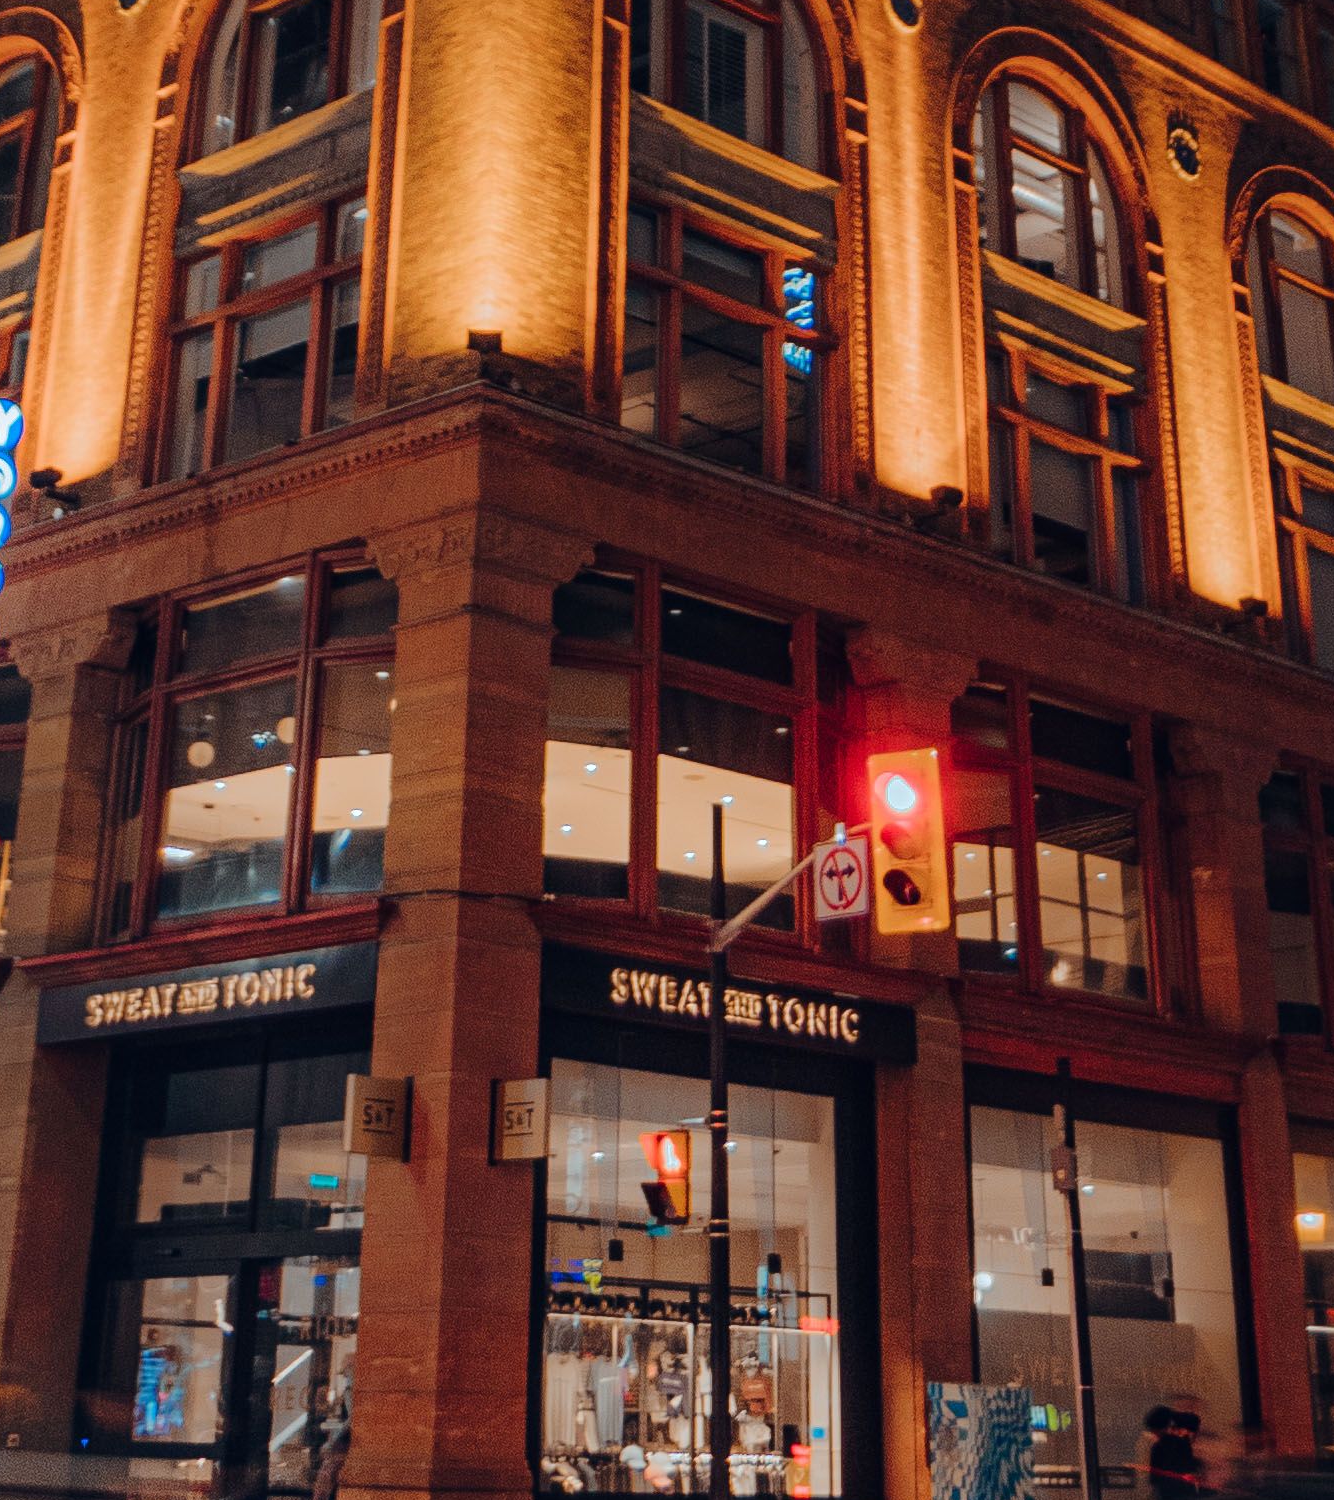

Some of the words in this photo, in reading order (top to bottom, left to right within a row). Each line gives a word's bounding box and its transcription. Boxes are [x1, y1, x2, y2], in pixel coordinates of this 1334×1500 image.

[84, 983, 177, 1028] SWEAT
[178, 980, 219, 1012] AND
[221, 963, 316, 1009] TONIC
[610, 968, 712, 1018] SWEAT
[766, 993, 860, 1043] TONIC
